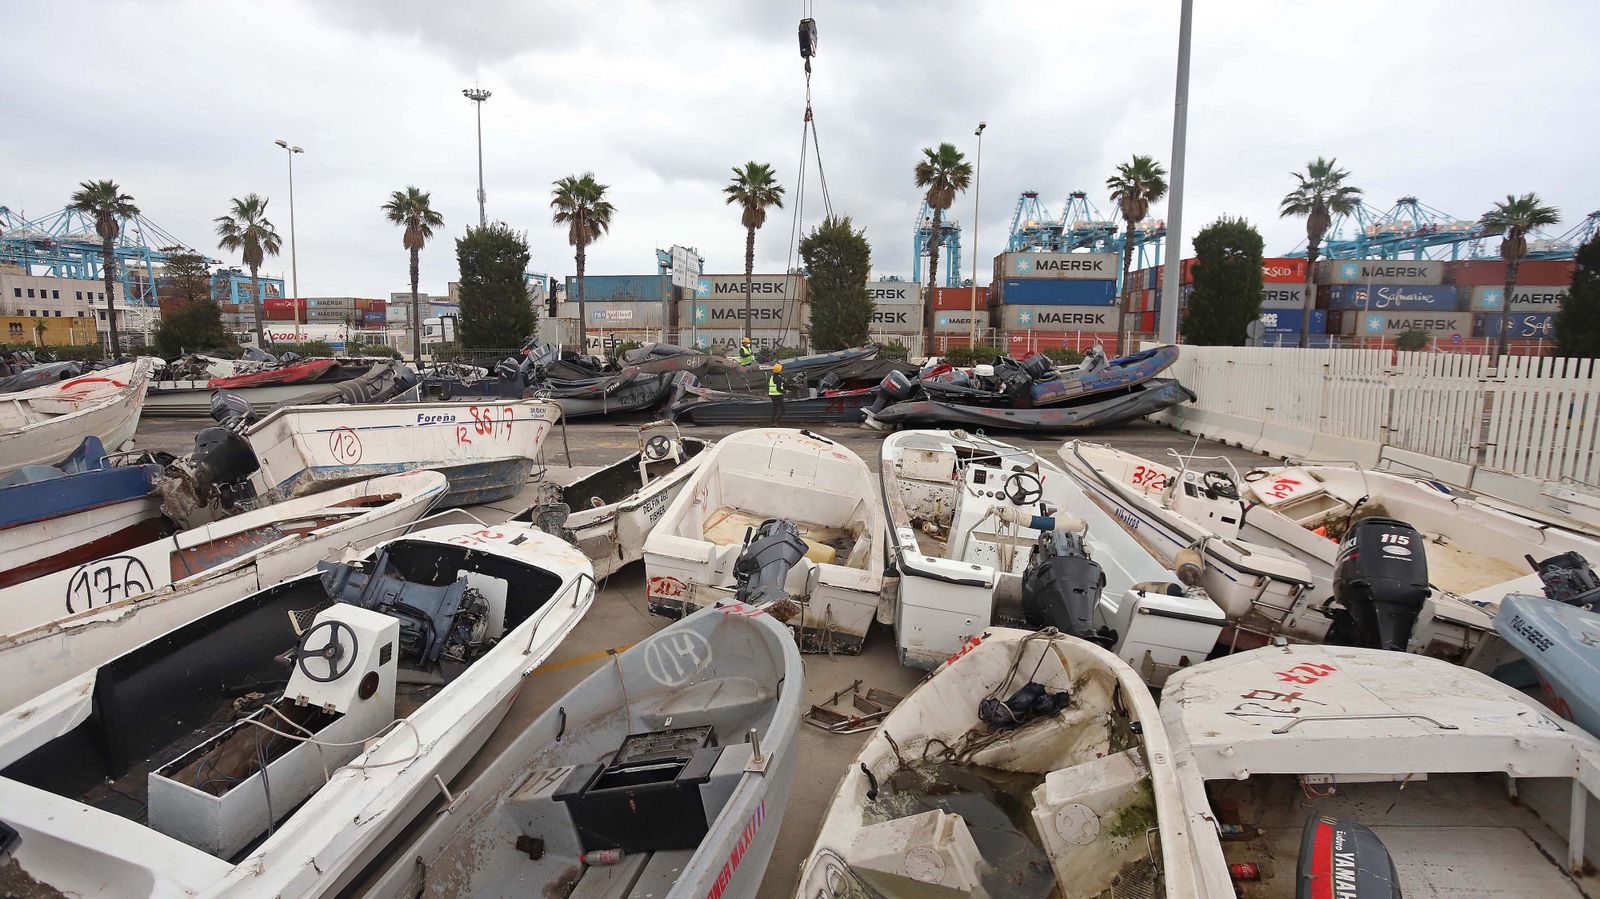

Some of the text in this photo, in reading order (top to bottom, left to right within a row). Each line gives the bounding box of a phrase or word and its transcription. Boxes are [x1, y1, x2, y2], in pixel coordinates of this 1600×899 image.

[1036, 260, 1103, 271] MAERSK
[1361, 267, 1428, 278] MAERSK
[714, 282, 784, 294] MAERSK
[865, 289, 906, 299] ERSK
[1376, 287, 1435, 308] Safmarine
[711, 308, 783, 320] MAERSK
[1037, 313, 1105, 324] MAERSK
[1387, 319, 1457, 331] MAERSK
[417, 412, 456, 423] Foreña
[1381, 533, 1410, 545] 115
[1335, 830, 1347, 851] Enduro
